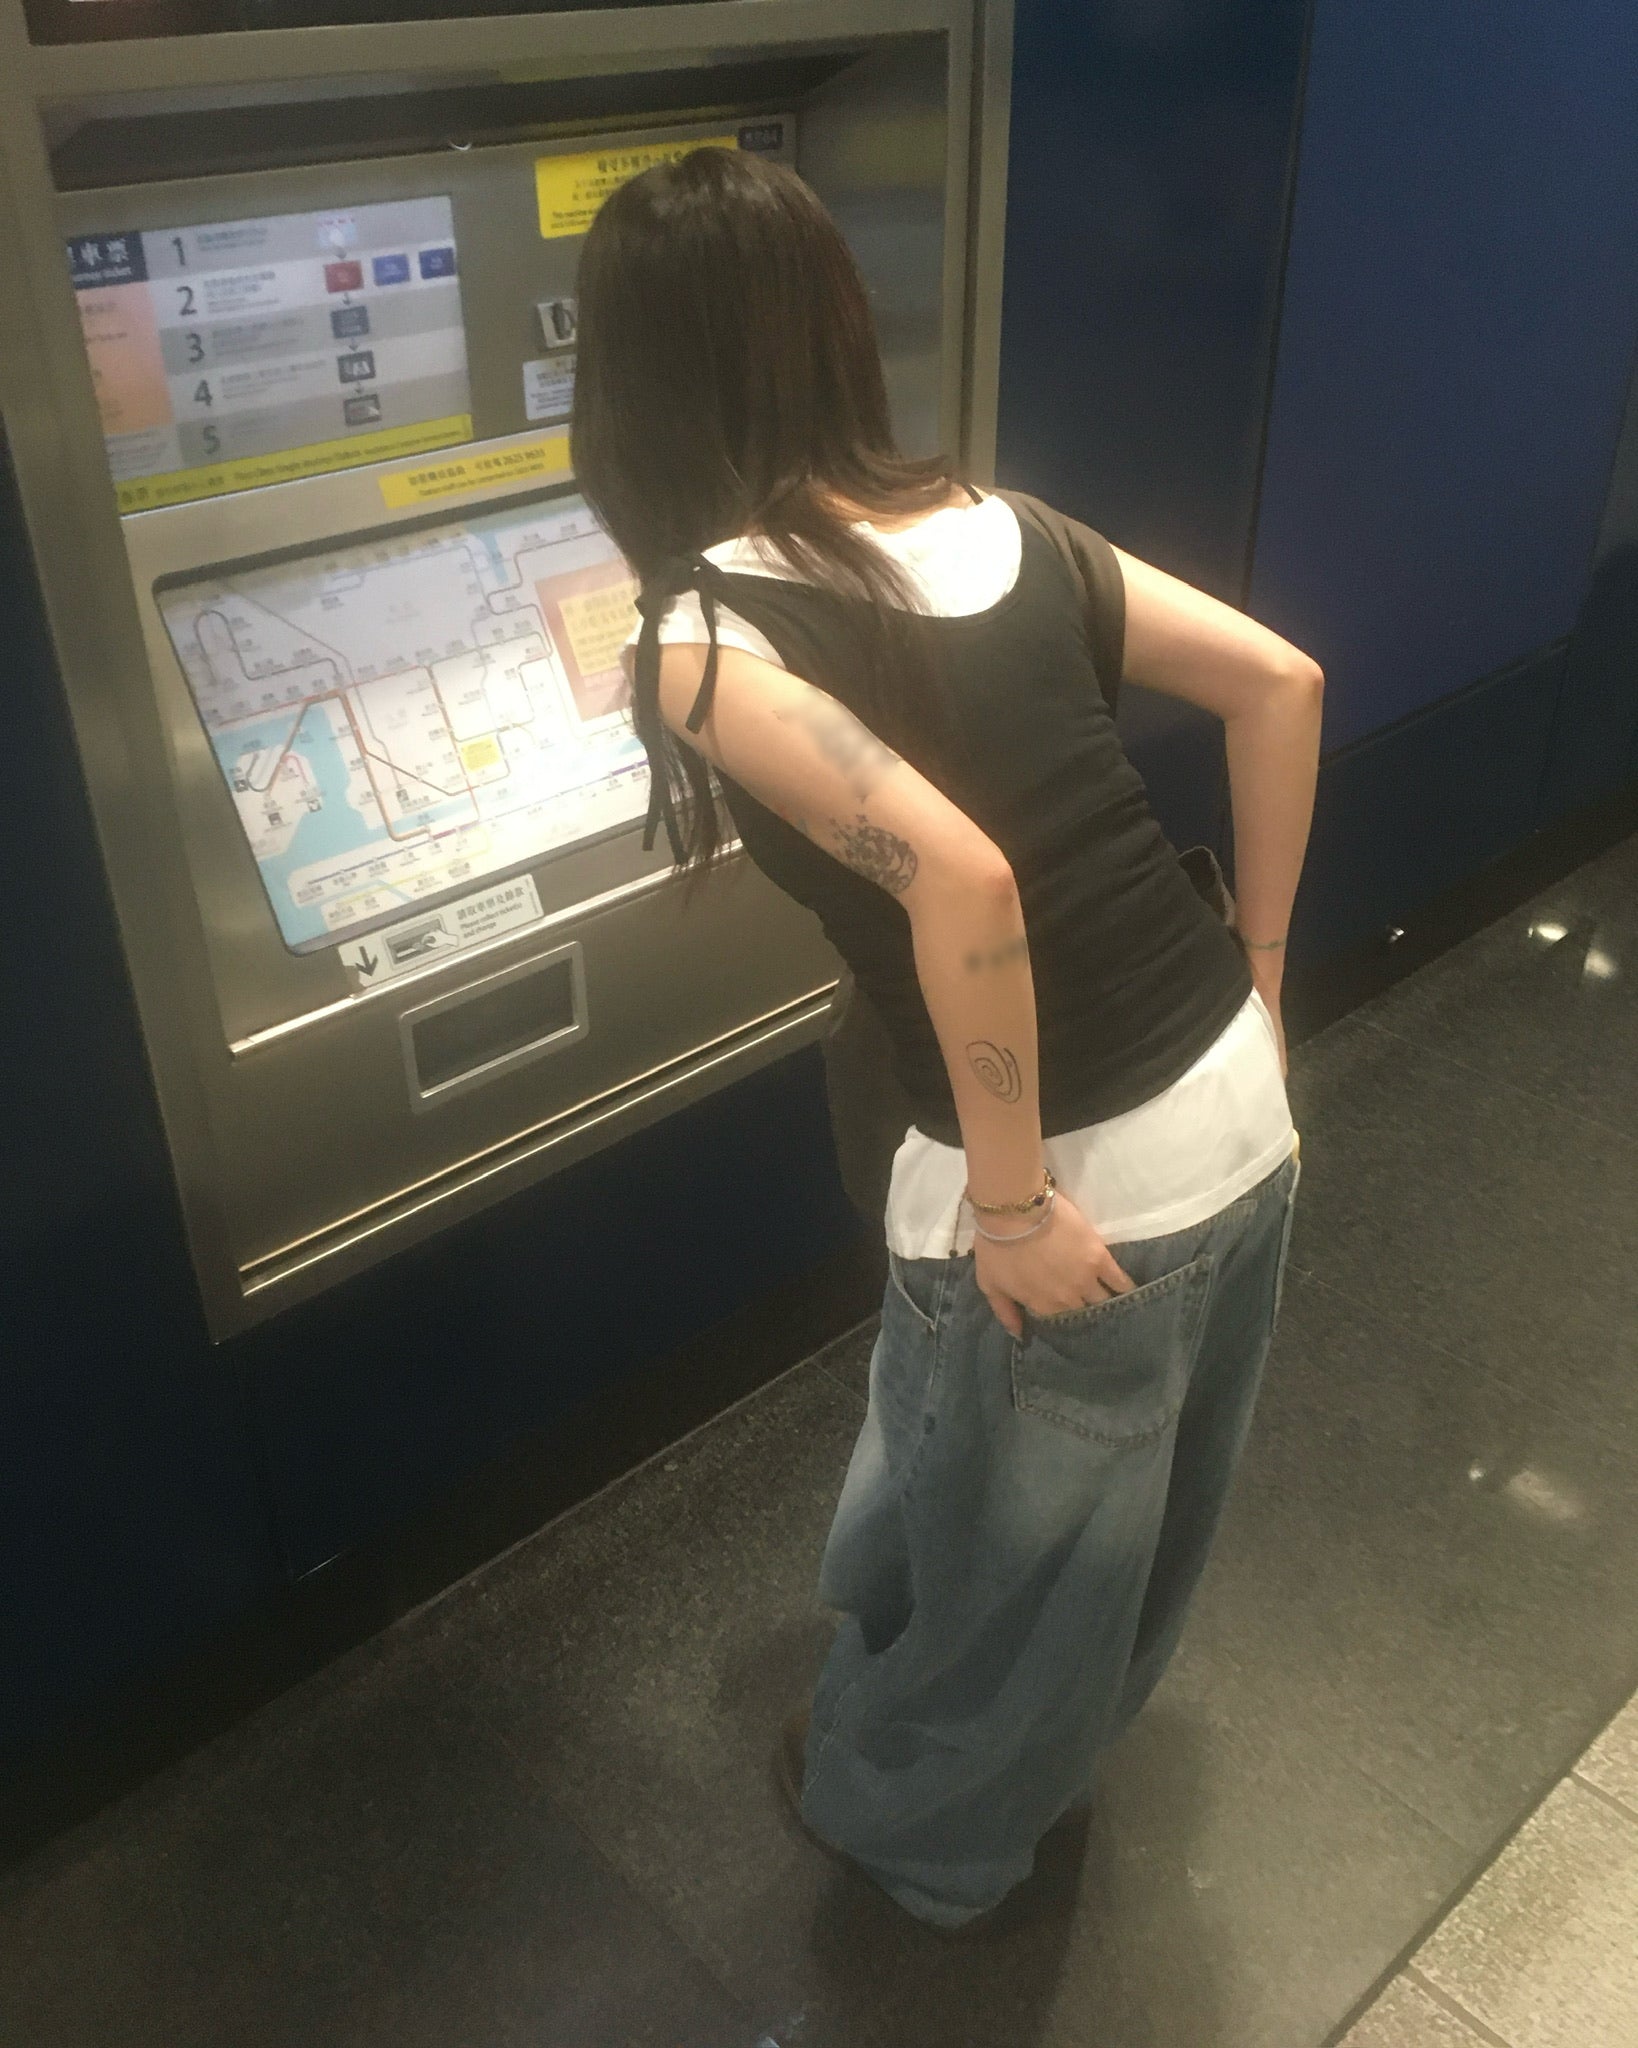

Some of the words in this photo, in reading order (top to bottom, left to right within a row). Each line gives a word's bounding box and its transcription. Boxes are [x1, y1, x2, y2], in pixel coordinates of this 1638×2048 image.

[172, 236, 186, 266] 1
[176, 285, 198, 316] 2
[186, 332, 206, 364] 3
[194, 379, 213, 407] 4
[203, 425, 221, 455] 5
